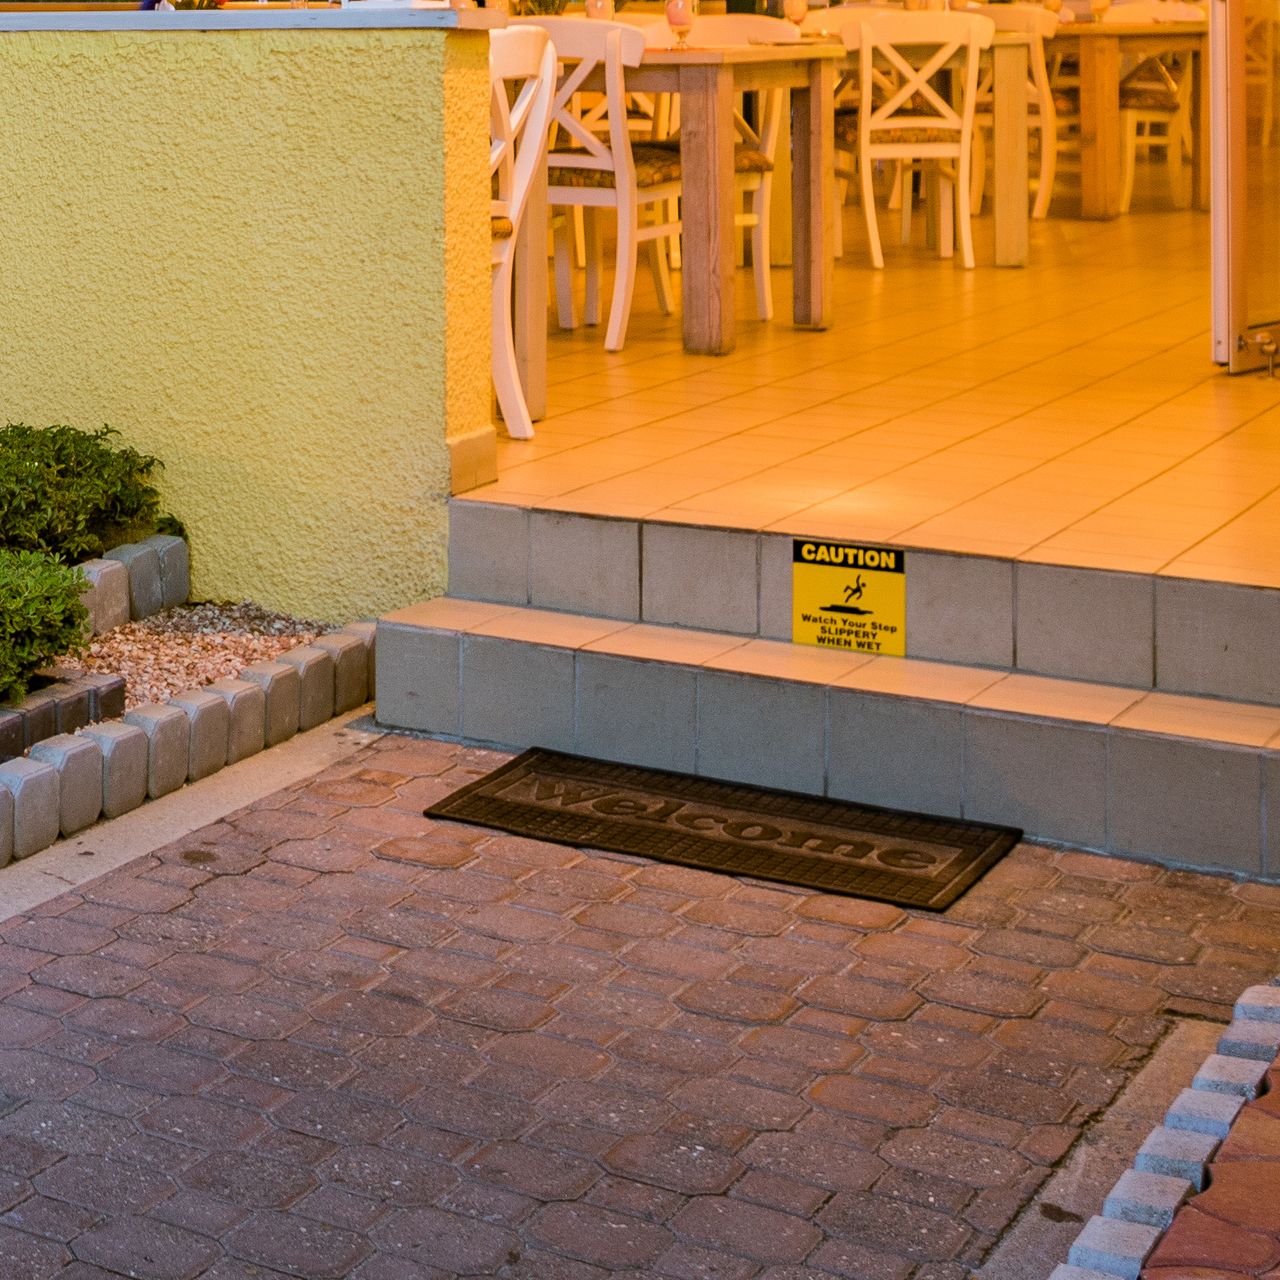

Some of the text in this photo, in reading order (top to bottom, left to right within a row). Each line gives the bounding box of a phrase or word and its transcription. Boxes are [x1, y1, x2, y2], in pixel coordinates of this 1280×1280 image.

[801, 543, 896, 568] CAUTION
[801, 613, 897, 633] Watch Your Step
[820, 626, 878, 640] SLIPPERY
[817, 636, 882, 651] WHEN WET
[529, 775, 941, 872] Welcome
